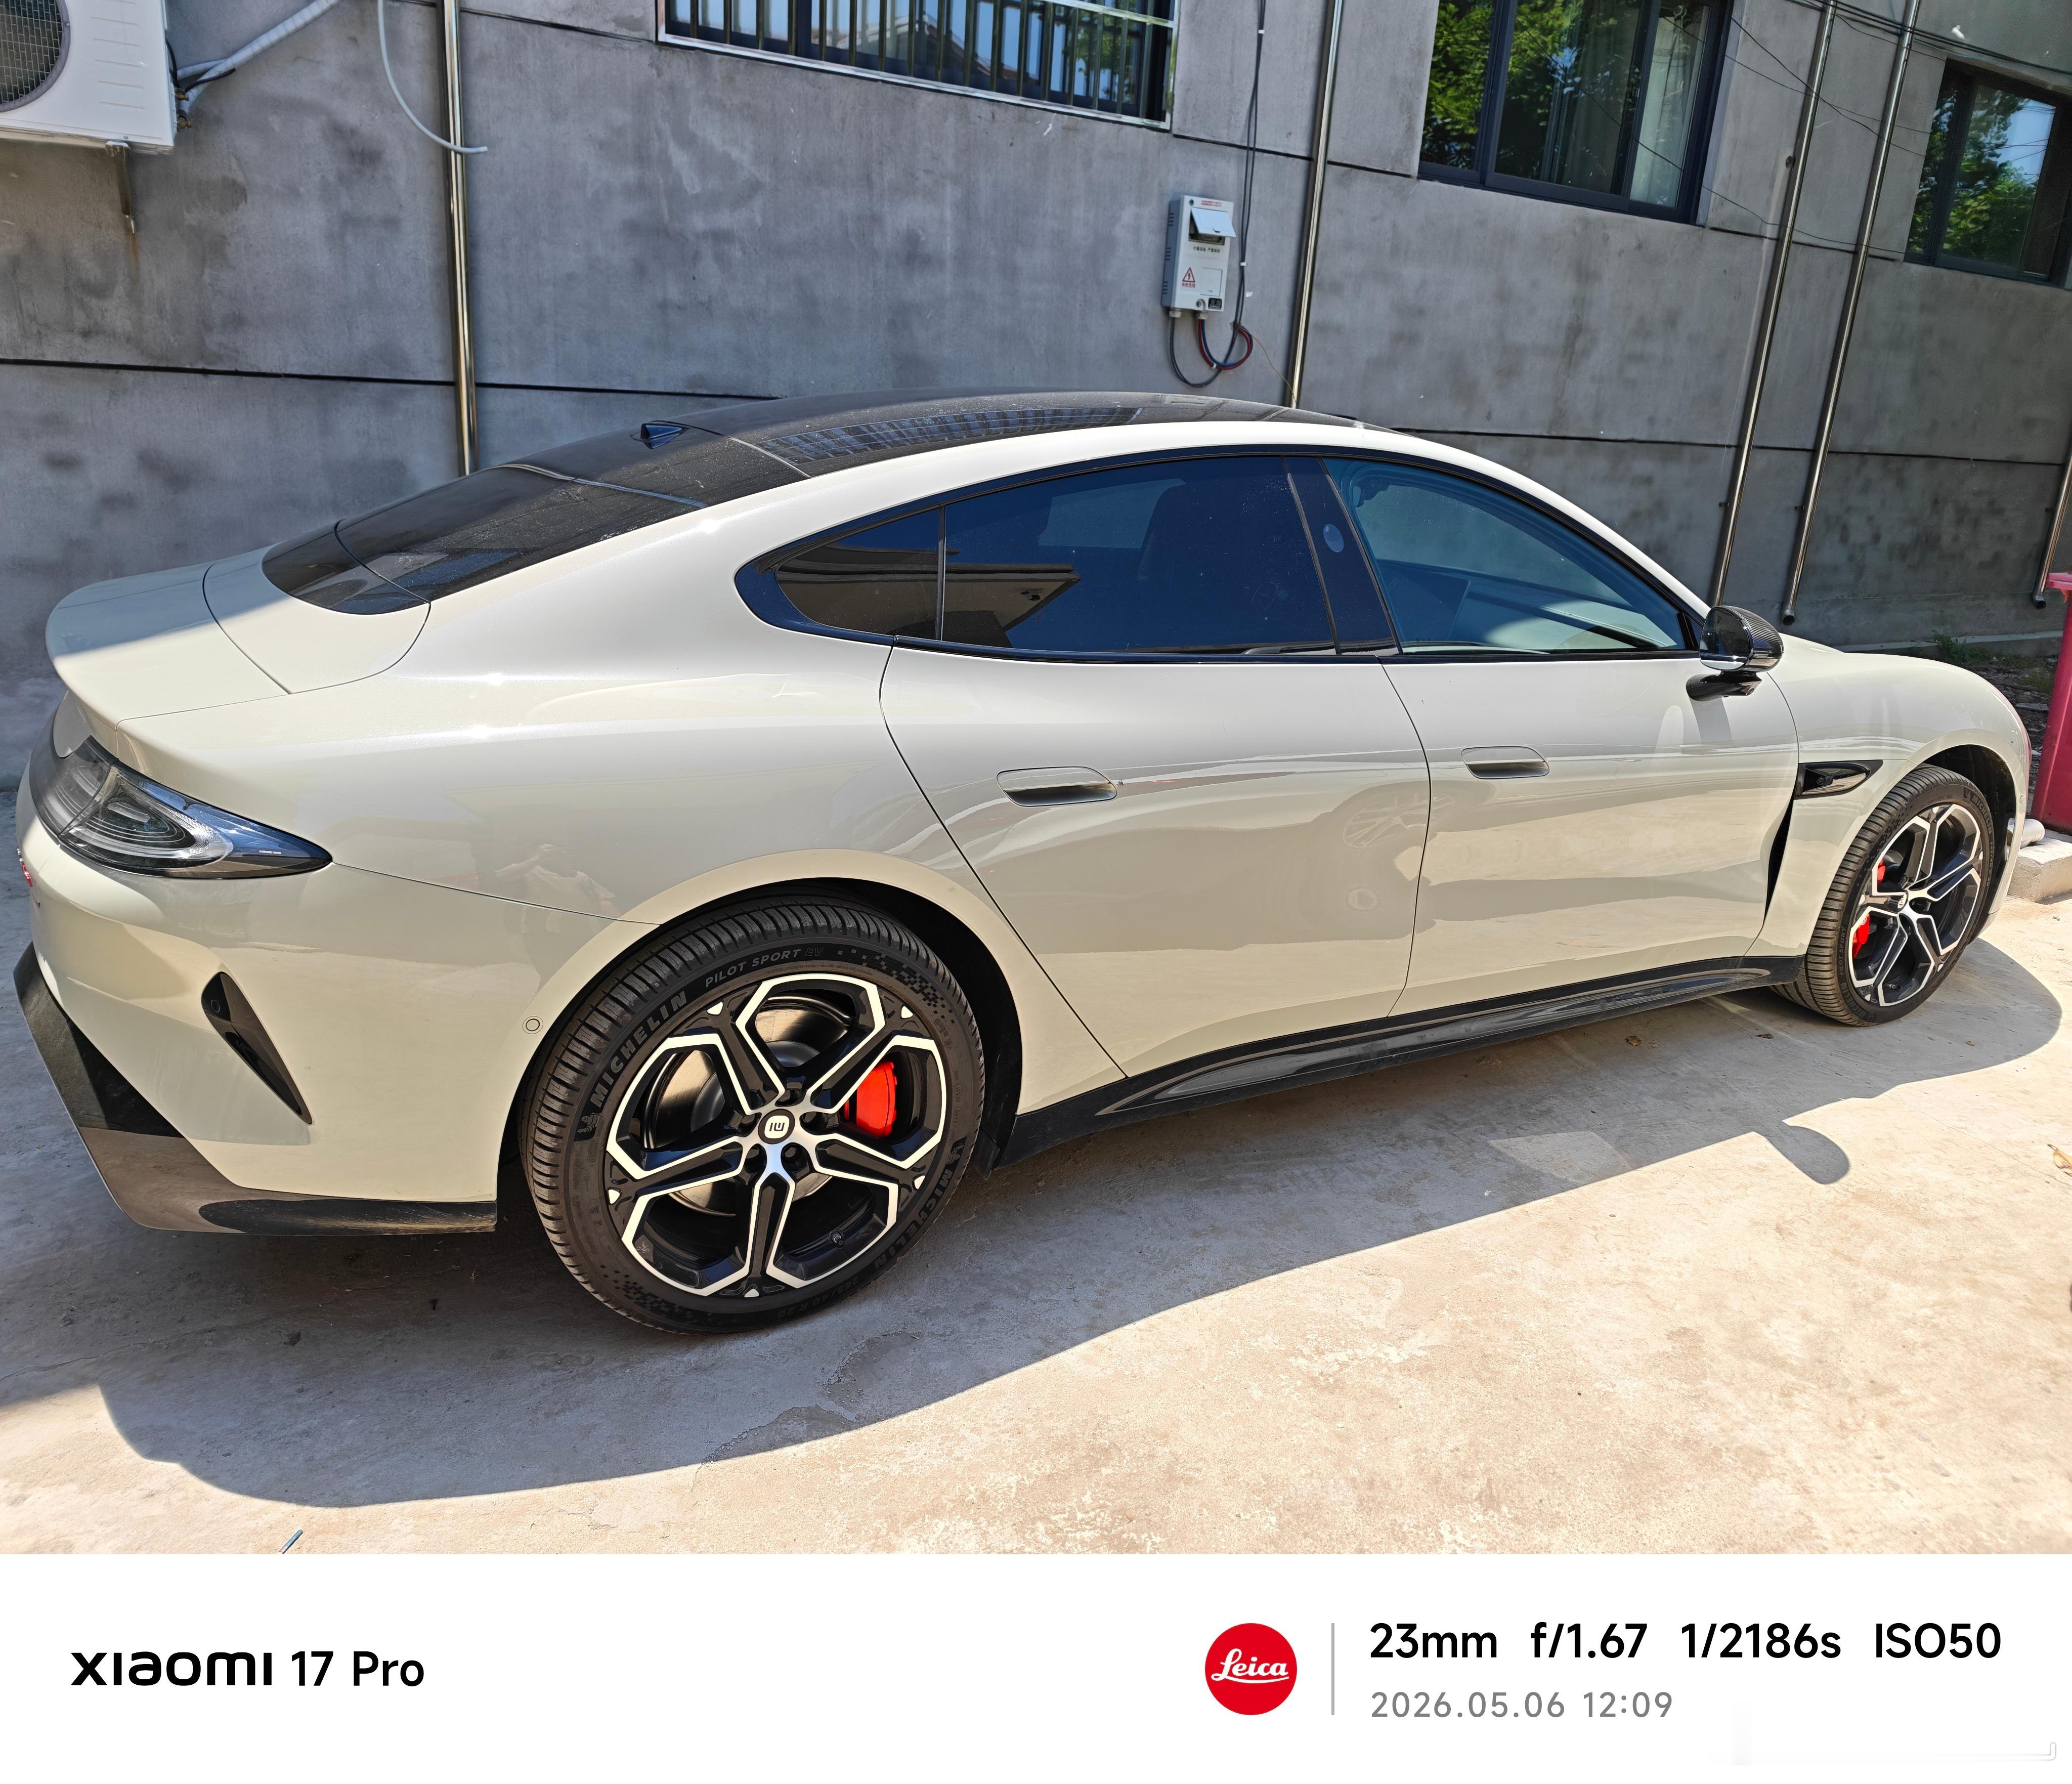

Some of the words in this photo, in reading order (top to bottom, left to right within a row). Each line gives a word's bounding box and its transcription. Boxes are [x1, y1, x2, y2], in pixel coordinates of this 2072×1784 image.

[1971, 794, 1993, 834] MICHELIN
[705, 961, 747, 988] PILOT
[752, 949, 802, 967] SPORT
[805, 947, 825, 957] EV
[590, 991, 687, 1108] MICHELIN
[874, 1169, 954, 1270] MICHELIN
